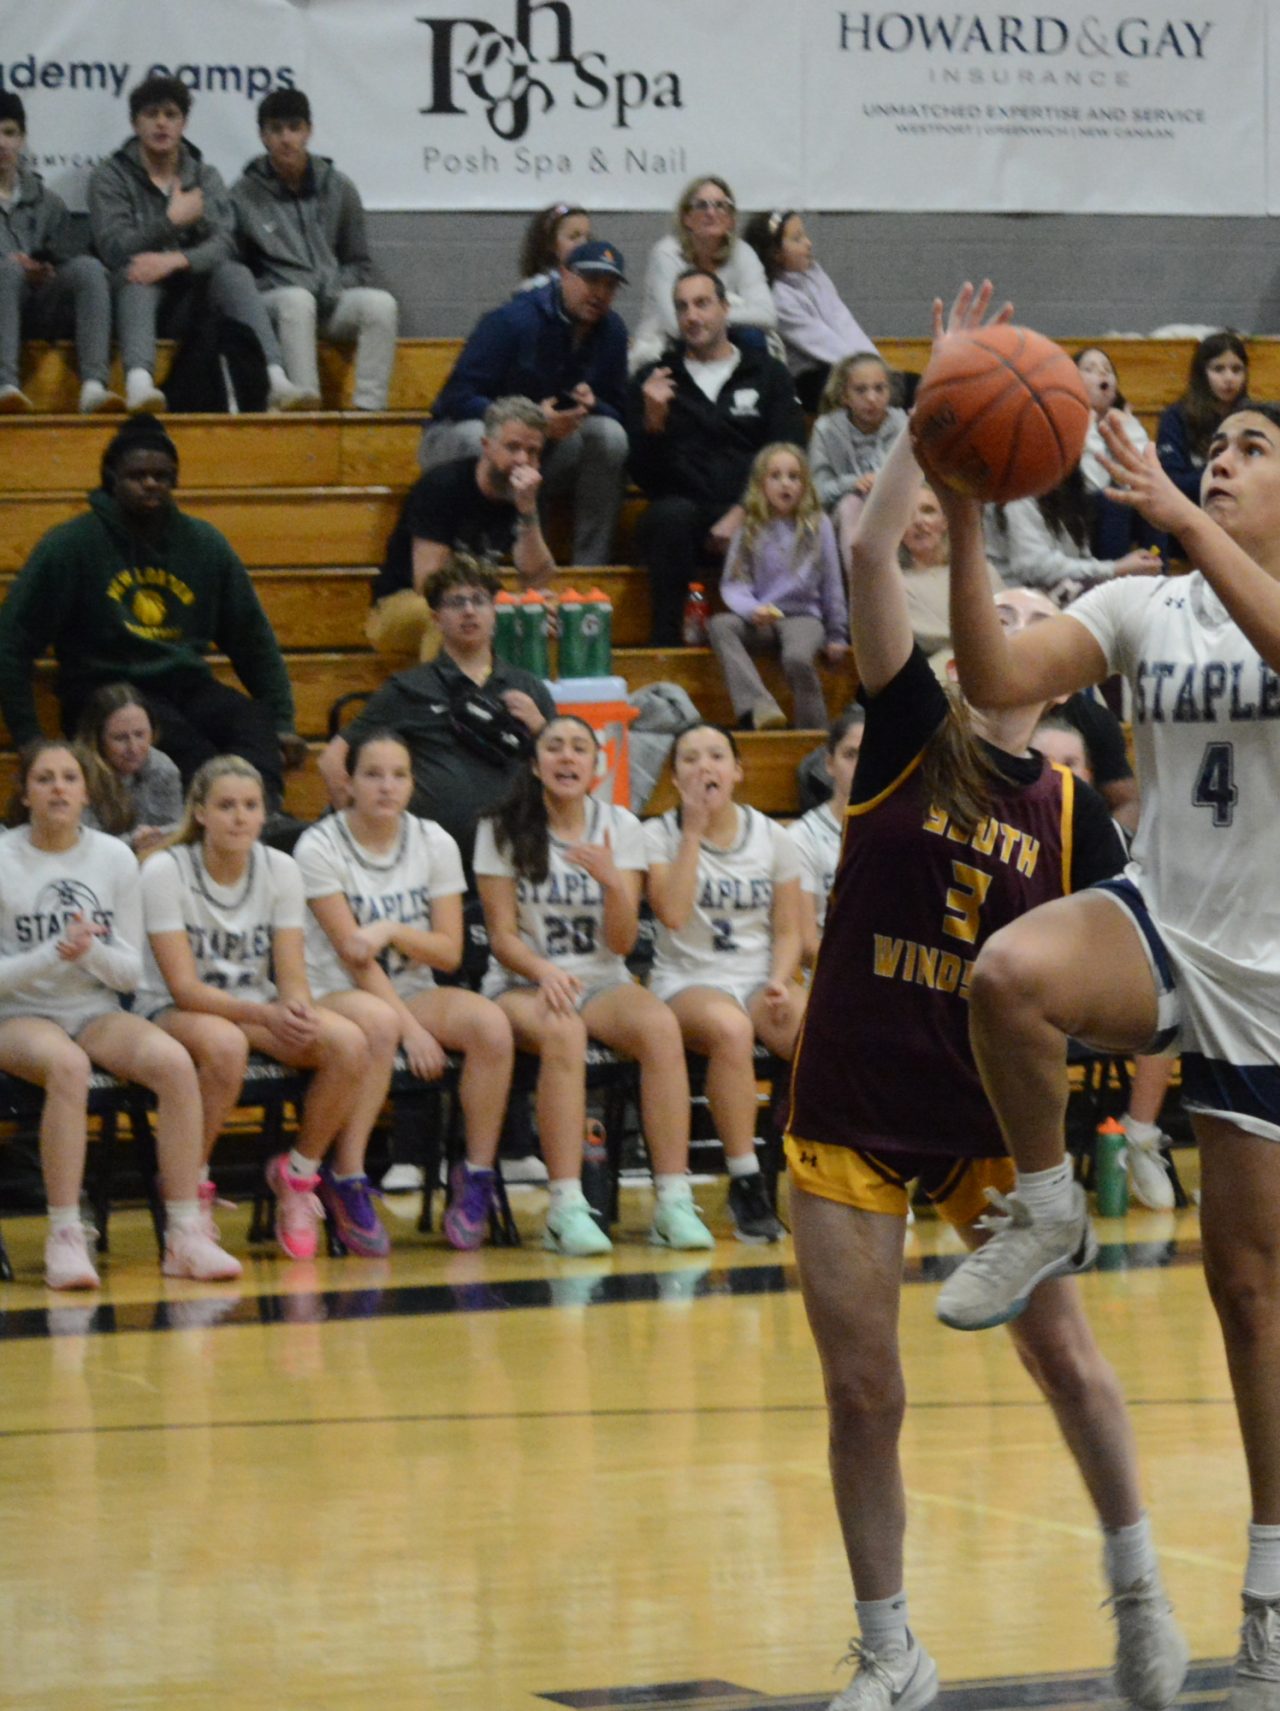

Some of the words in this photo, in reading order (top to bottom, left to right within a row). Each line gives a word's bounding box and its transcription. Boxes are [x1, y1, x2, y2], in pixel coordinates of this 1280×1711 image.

[0, 54, 129, 98] demy
[574, 51, 685, 129] Spa
[928, 68, 1130, 88] INSURANCE
[862, 103, 982, 118] UNMATCHED
[985, 104, 1081, 121] EXPERTISE
[1086, 107, 1128, 121] AND
[1132, 107, 1206, 124] SERVICE
[422, 146, 500, 175] Posh
[513, 148, 573, 180] Spa
[588, 149, 610, 174] &
[625, 148, 688, 175] Nail
[1192, 741, 1238, 827] 4
[942, 860, 993, 945] 3
[874, 934, 977, 998] WINDS
